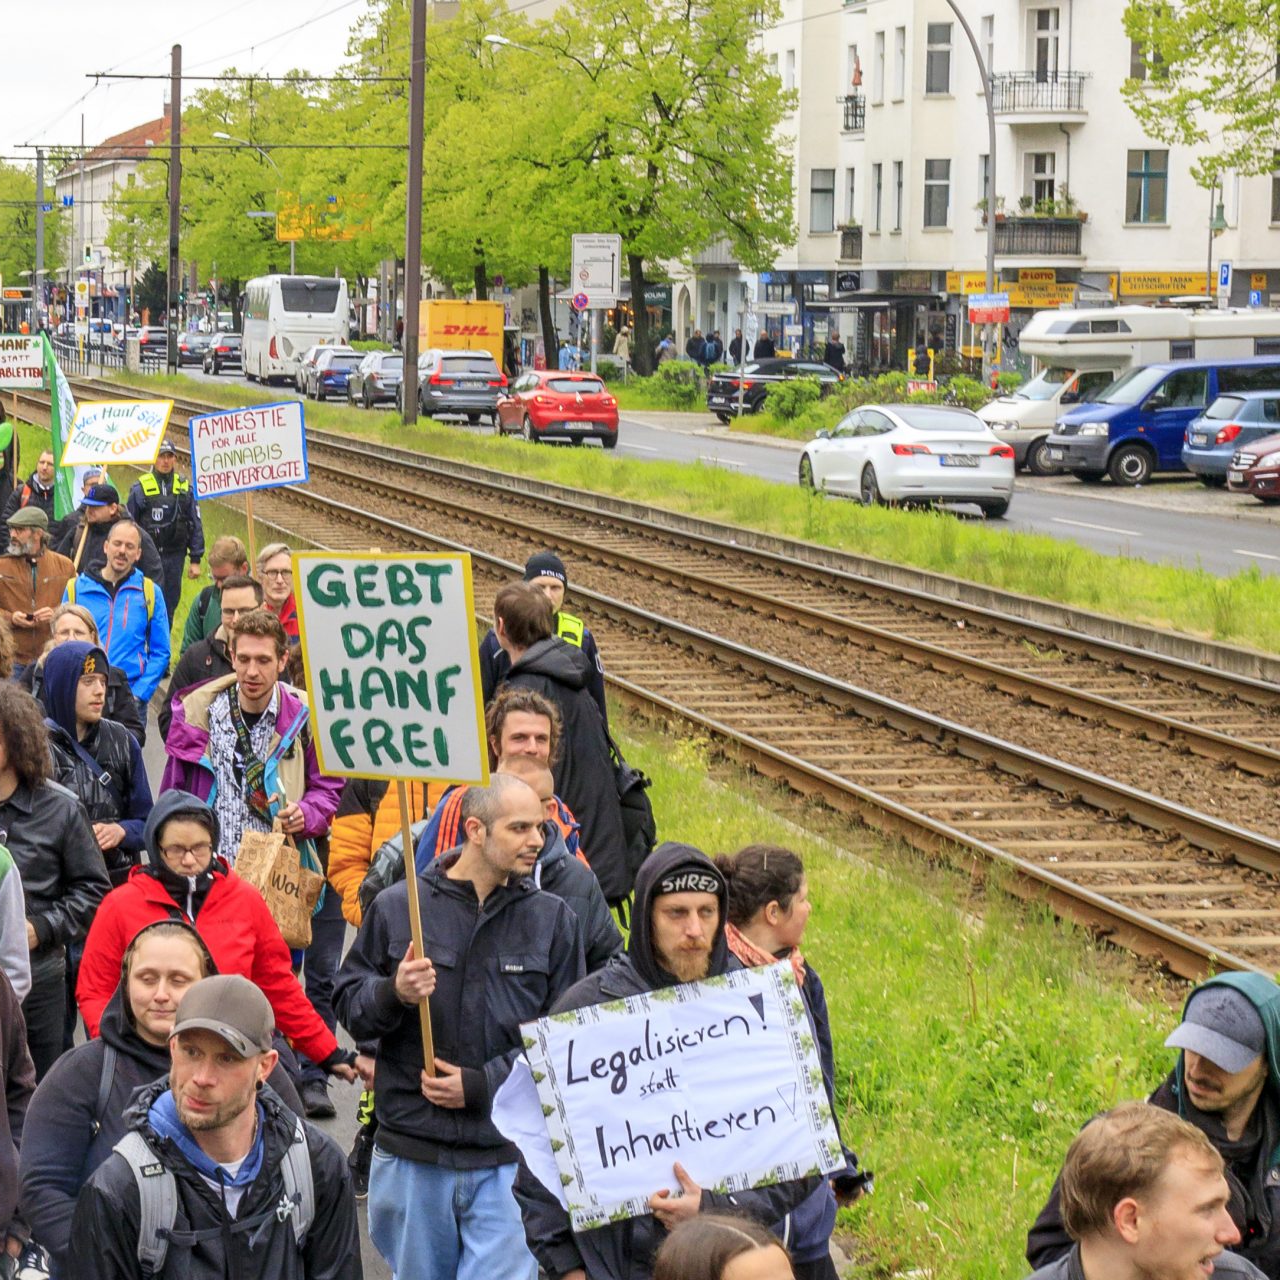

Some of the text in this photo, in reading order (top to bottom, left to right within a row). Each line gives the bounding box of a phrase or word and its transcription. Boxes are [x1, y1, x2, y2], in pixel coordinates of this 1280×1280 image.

[1030, 272, 1054, 280] LOTTO
[443, 325, 490, 336] DHL
[2, 354, 30, 363] STATT
[75, 412, 98, 431] Wer
[102, 405, 140, 420] Hanf
[198, 407, 287, 438] AMNESTIE
[111, 425, 156, 456] GLÜCK
[211, 432, 257, 450] FÜR ALLE
[200, 443, 283, 472] CANNABIS
[197, 460, 302, 494] STRAFVERFOLGTE
[306, 562, 453, 608] GEBT
[340, 615, 433, 665] DAS
[319, 664, 462, 716] HANF
[329, 718, 451, 769] FREI
[661, 873, 719, 893] SHRED
[566, 991, 768, 1096] Legalisieren!
[638, 1067, 681, 1098] statt
